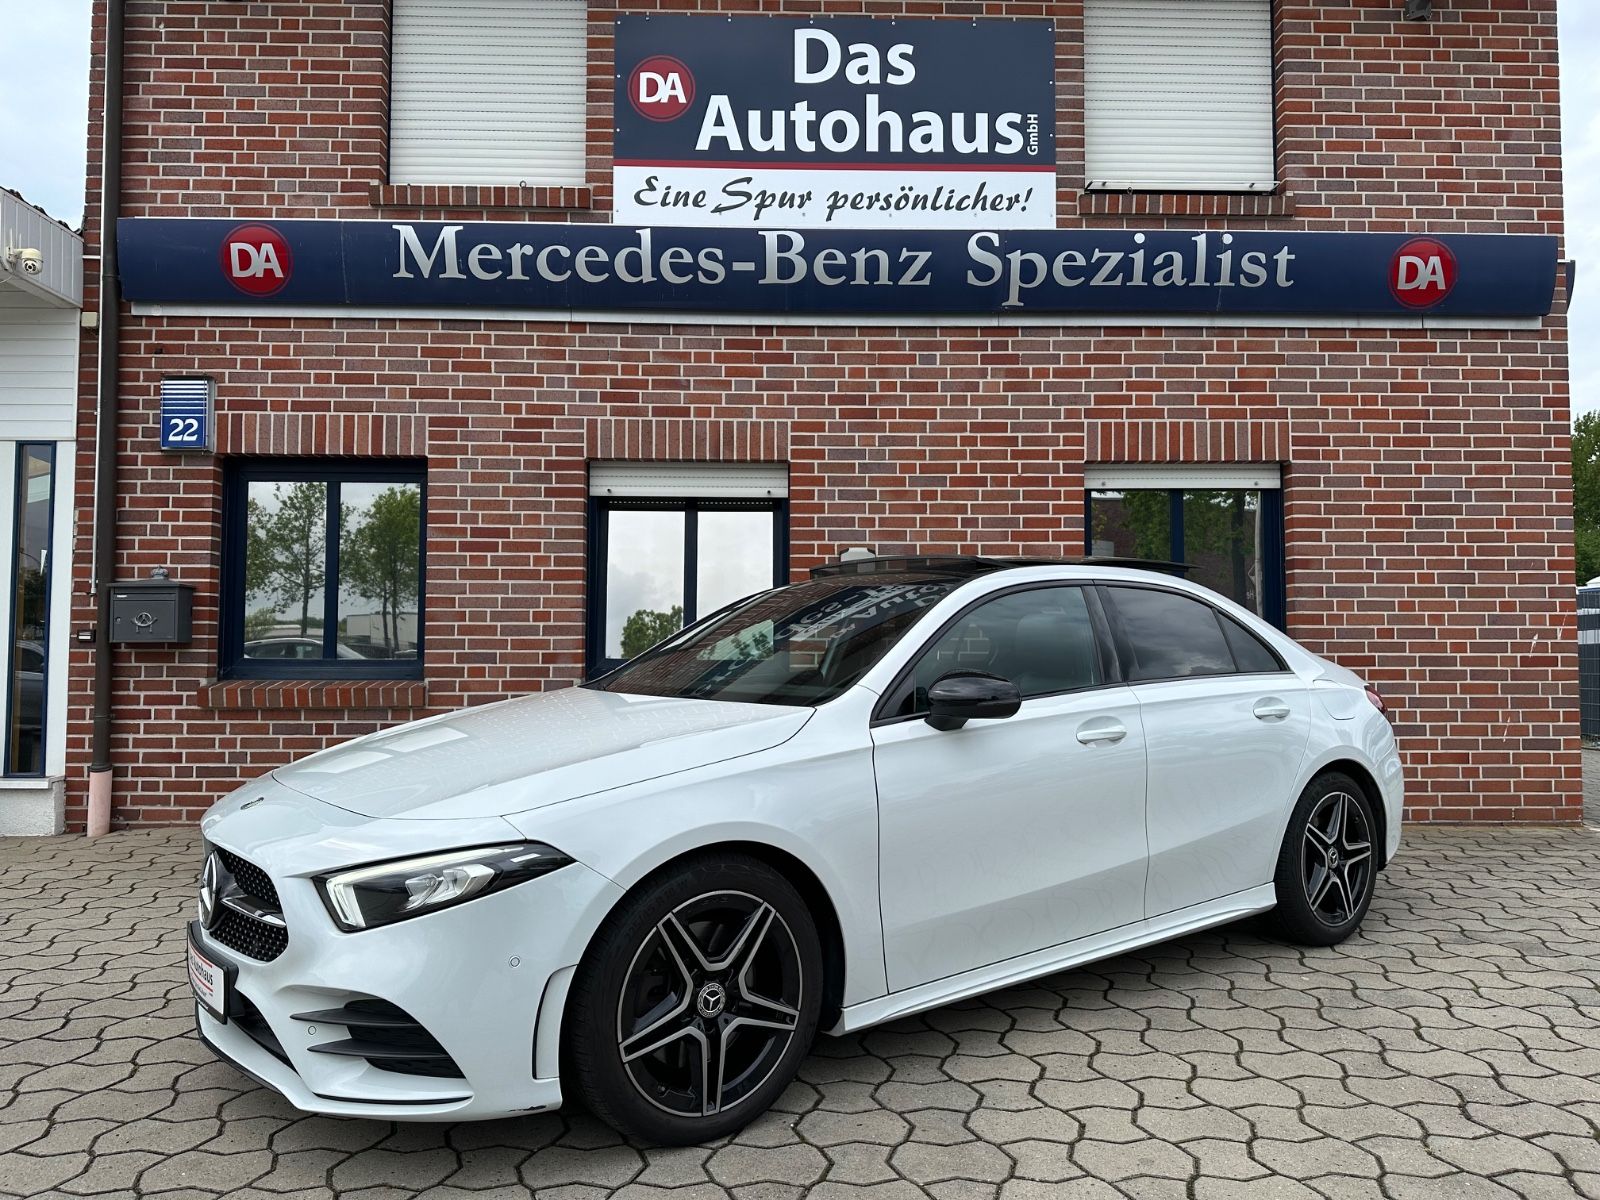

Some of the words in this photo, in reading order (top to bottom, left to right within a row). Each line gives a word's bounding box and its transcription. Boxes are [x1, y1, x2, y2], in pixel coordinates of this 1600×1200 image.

[794, 28, 916, 86] Das
[639, 72, 687, 104] DA
[695, 94, 1024, 155] Autohaus
[1027, 114, 1039, 156] GmbH
[633, 176, 707, 208] Eine
[710, 177, 812, 220] Spur
[826, 182, 1033, 221] persönlicher!
[229, 242, 284, 278] DA
[392, 224, 932, 286] Mercedes-Benz
[966, 231, 1296, 307] Spezialist
[1397, 255, 1446, 290] DA
[168, 418, 199, 441] 22
